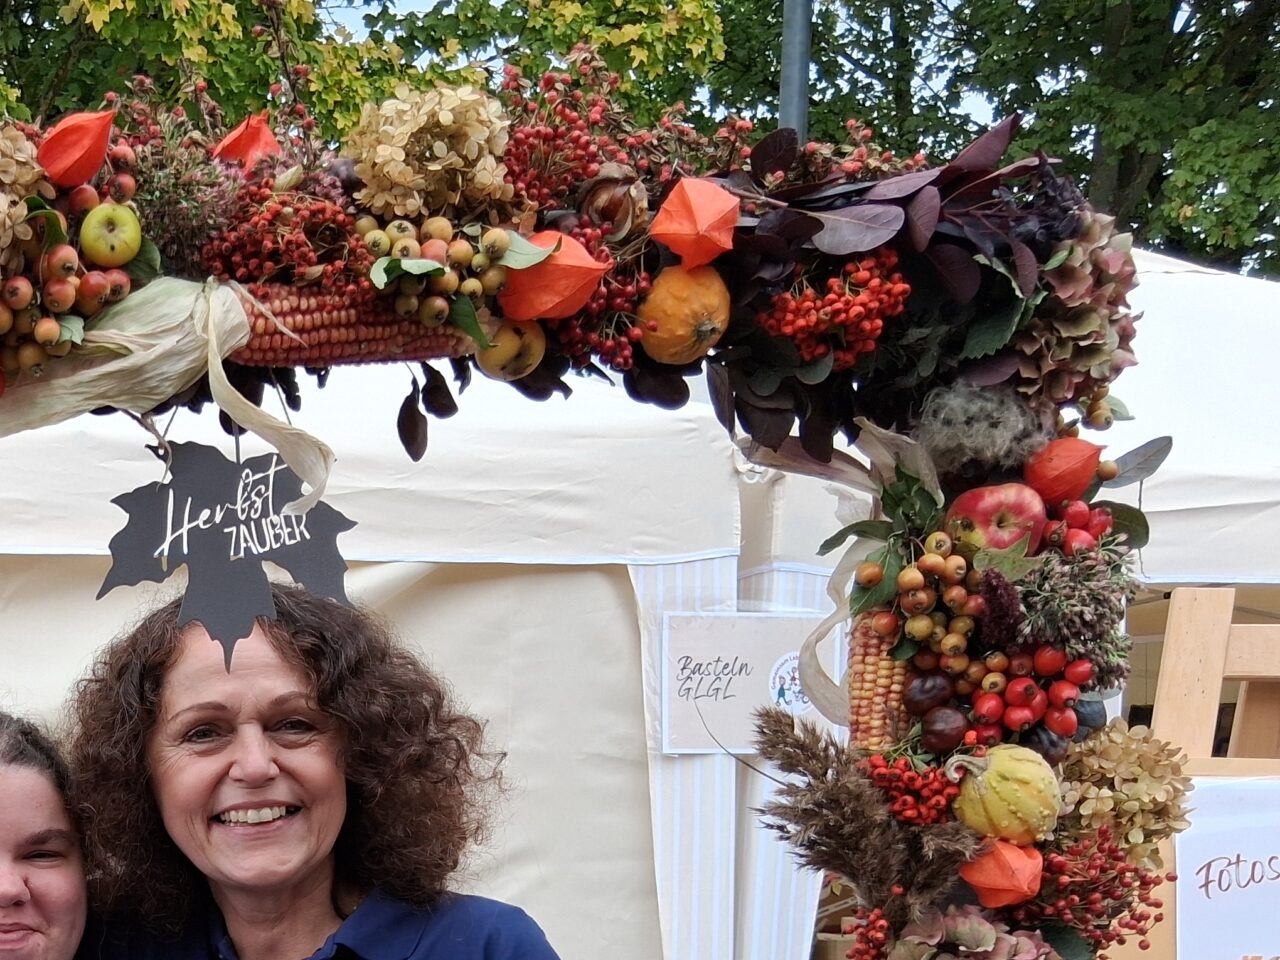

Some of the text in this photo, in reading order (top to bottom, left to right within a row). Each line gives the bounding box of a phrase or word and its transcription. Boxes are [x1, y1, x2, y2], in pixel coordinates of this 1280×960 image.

[154, 455, 288, 571] Herbst
[223, 513, 311, 560] ZAUBER
[677, 655, 753, 680] Basteln
[677, 676, 736, 701] GLGL
